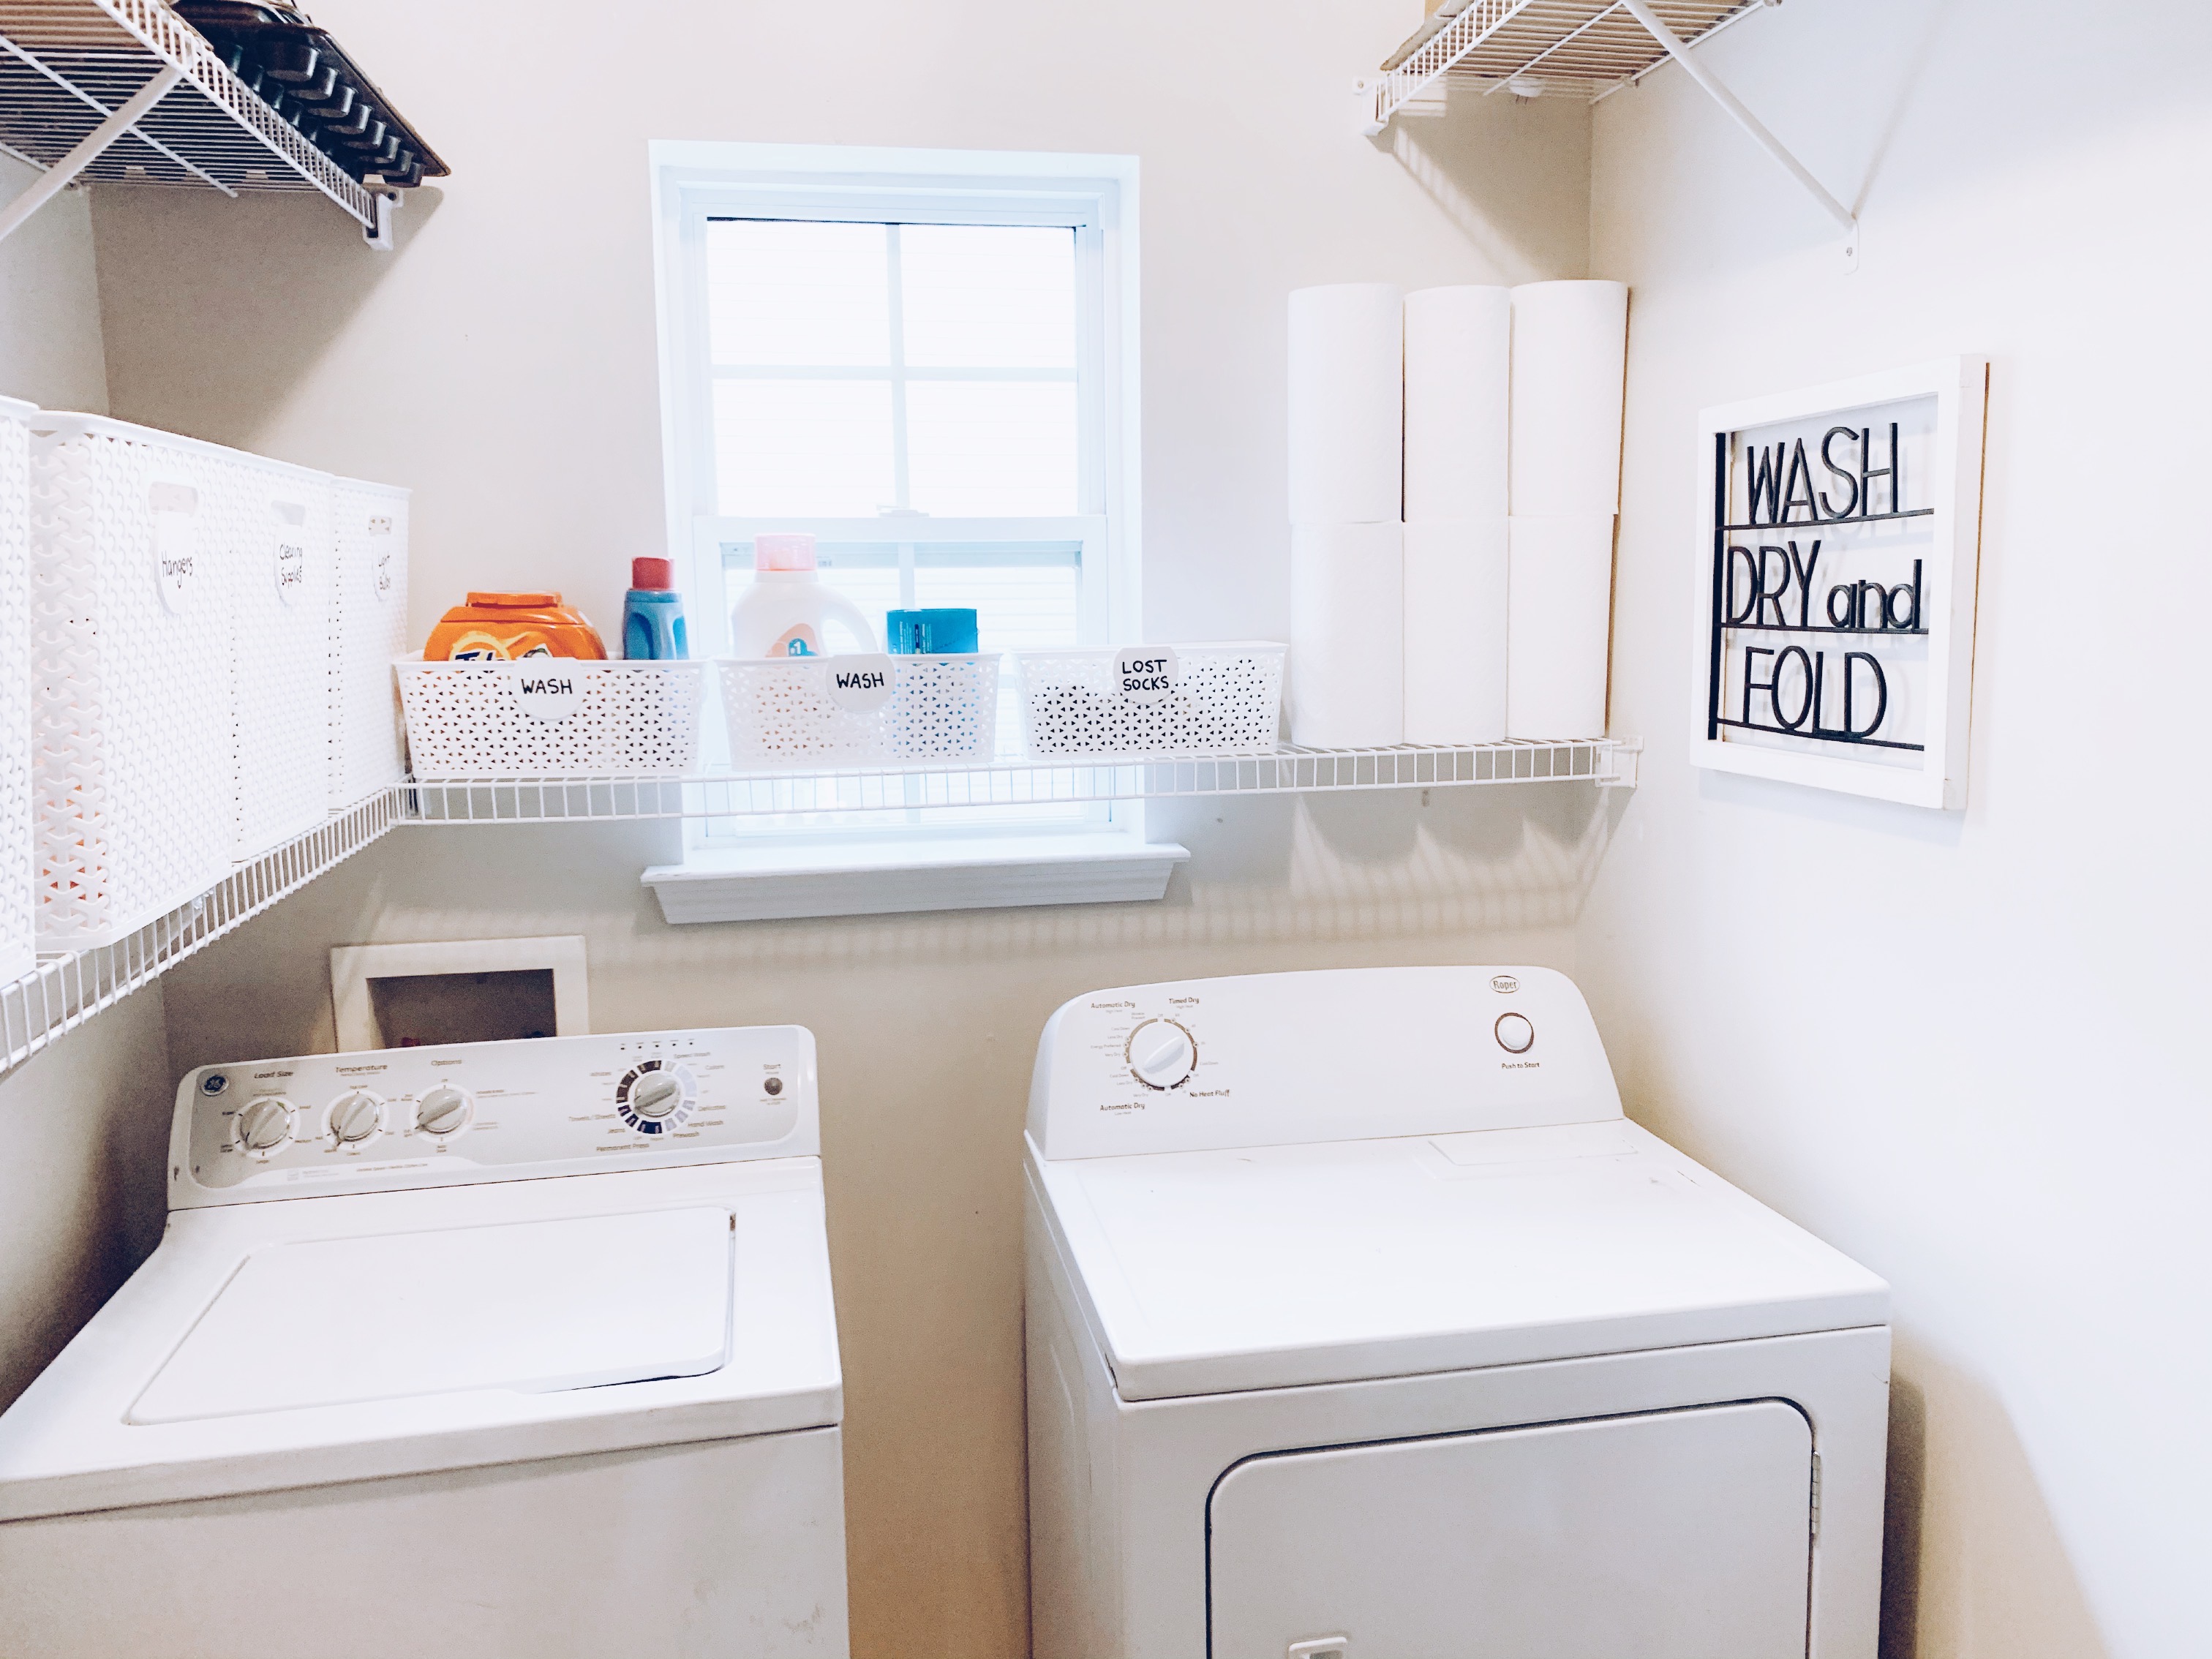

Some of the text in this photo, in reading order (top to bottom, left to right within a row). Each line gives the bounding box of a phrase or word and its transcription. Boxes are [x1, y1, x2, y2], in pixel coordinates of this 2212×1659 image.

[1746, 422, 1898, 525] WASH
[161, 551, 193, 589] Hangers
[1726, 539, 1922, 630] DRY and
[1122, 659, 1167, 674] LOST
[521, 678, 573, 695] WASH
[835, 672, 885, 689] WASH
[1123, 675, 1170, 691] SOCKS
[1742, 645, 1887, 739] FOLD
[1493, 980, 1517, 990] Roper
[1124, 1001, 1135, 1009] Dry
[336, 1064, 388, 1073] Temperature
[1215, 1088, 1230, 1097] Fluff
[1133, 1102, 1146, 1110] Dry
